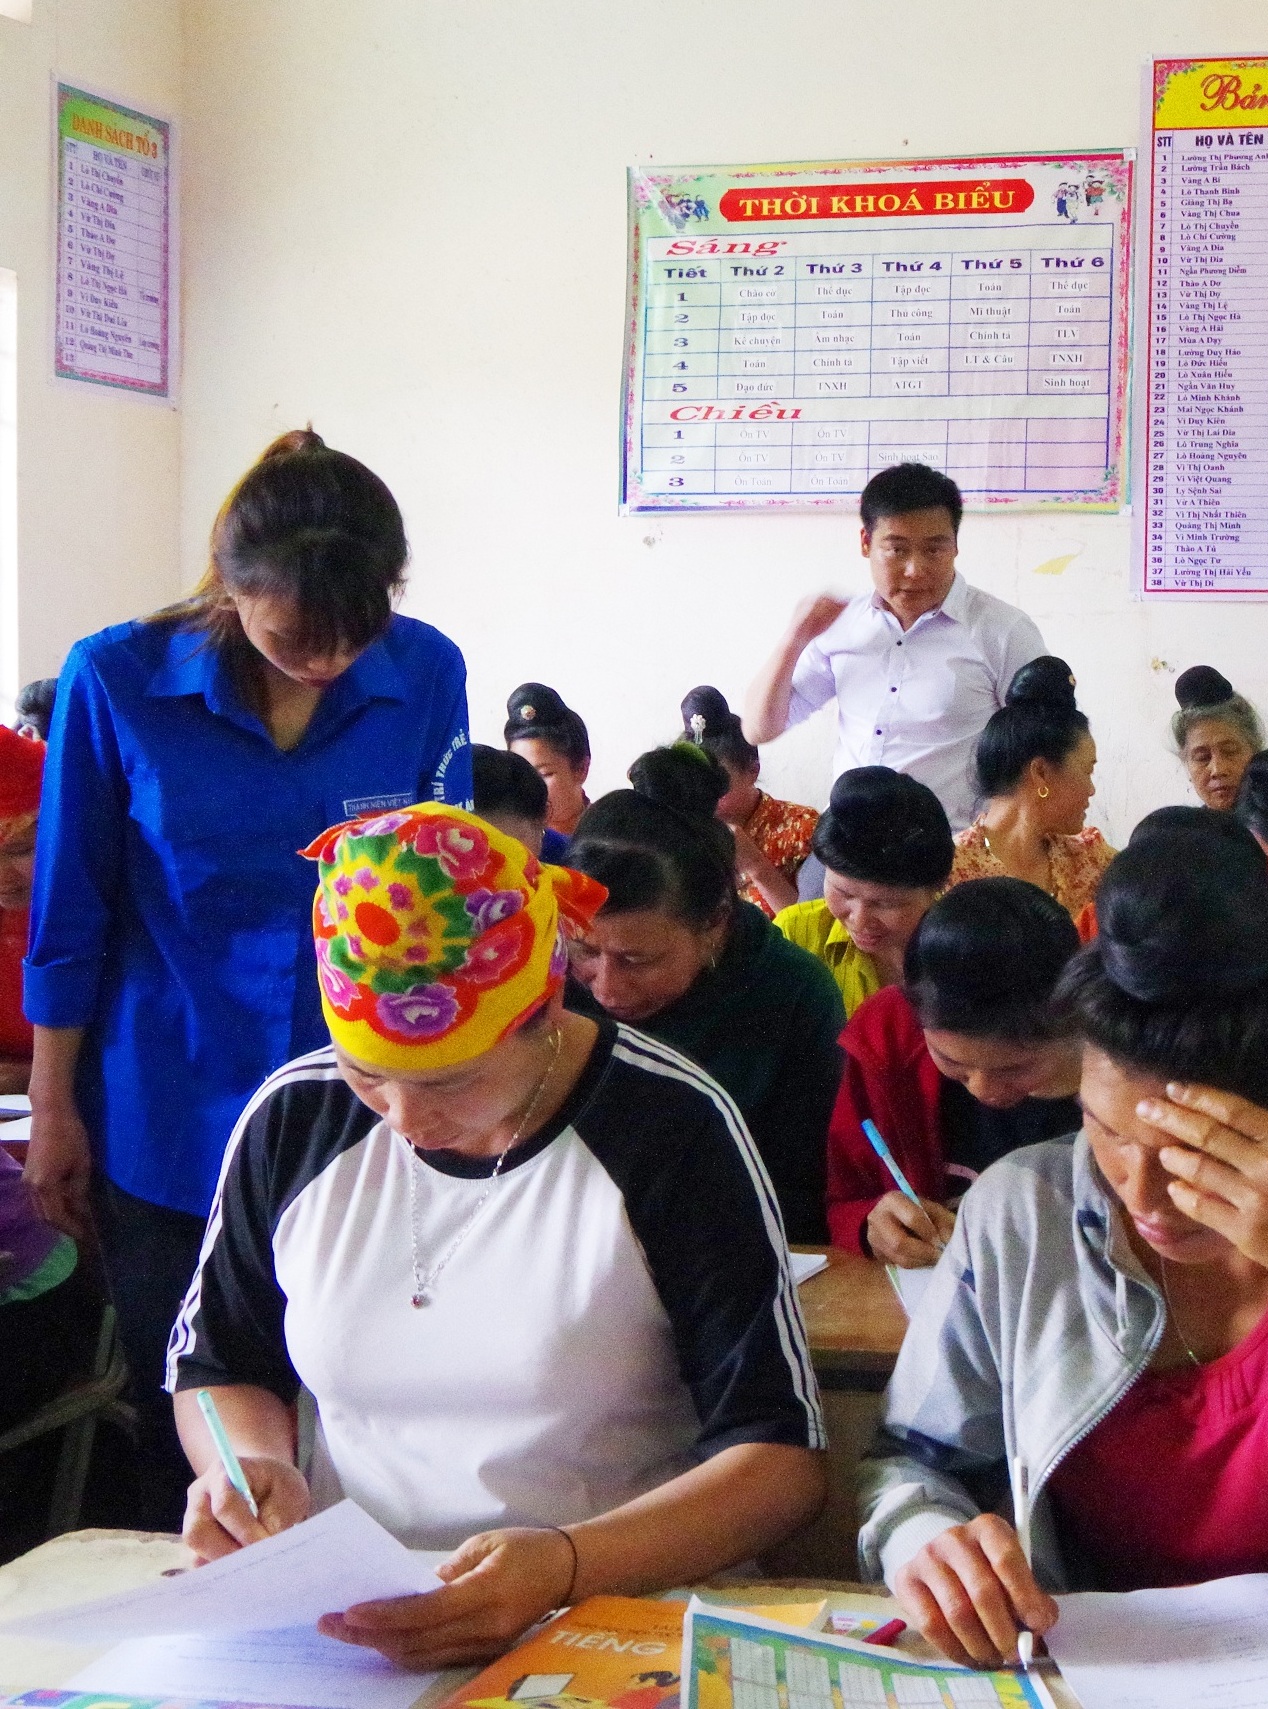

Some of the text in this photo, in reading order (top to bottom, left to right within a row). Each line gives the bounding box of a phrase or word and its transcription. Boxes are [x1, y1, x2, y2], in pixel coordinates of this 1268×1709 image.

[1157, 136, 1172, 147] STT
[1195, 132, 1263, 149] HỌ VÀ TÊN
[739, 182, 1015, 216] THỜI KHOÁ BIỂU
[666, 239, 787, 256] Sáng
[882, 261, 942, 271] Thứ 4
[961, 259, 1022, 269] Thứ 5
[1041, 257, 1104, 268] Thứ 6
[664, 266, 707, 278] Tiết
[731, 266, 784, 276] Thứ 2
[806, 263, 863, 274] Thứ 3
[677, 292, 688, 301] 1
[674, 313, 689, 324] 2
[674, 337, 689, 347] 3
[1052, 354, 1082, 363] TNXH
[672, 361, 688, 370] 4
[672, 383, 687, 392] 5
[819, 382, 847, 390] TNXH
[1044, 378, 1090, 389] Sinh hoạt
[670, 401, 802, 421] Chiều
[673, 430, 685, 439] 1
[755, 429, 770, 439] TV
[833, 429, 847, 438] TV
[669, 454, 686, 465] 2
[755, 453, 769, 462] TV
[831, 453, 845, 462] TV
[878, 451, 899, 462] Sinh
[668, 476, 685, 487] 3
[549, 1627, 668, 1656] TIẾNG
